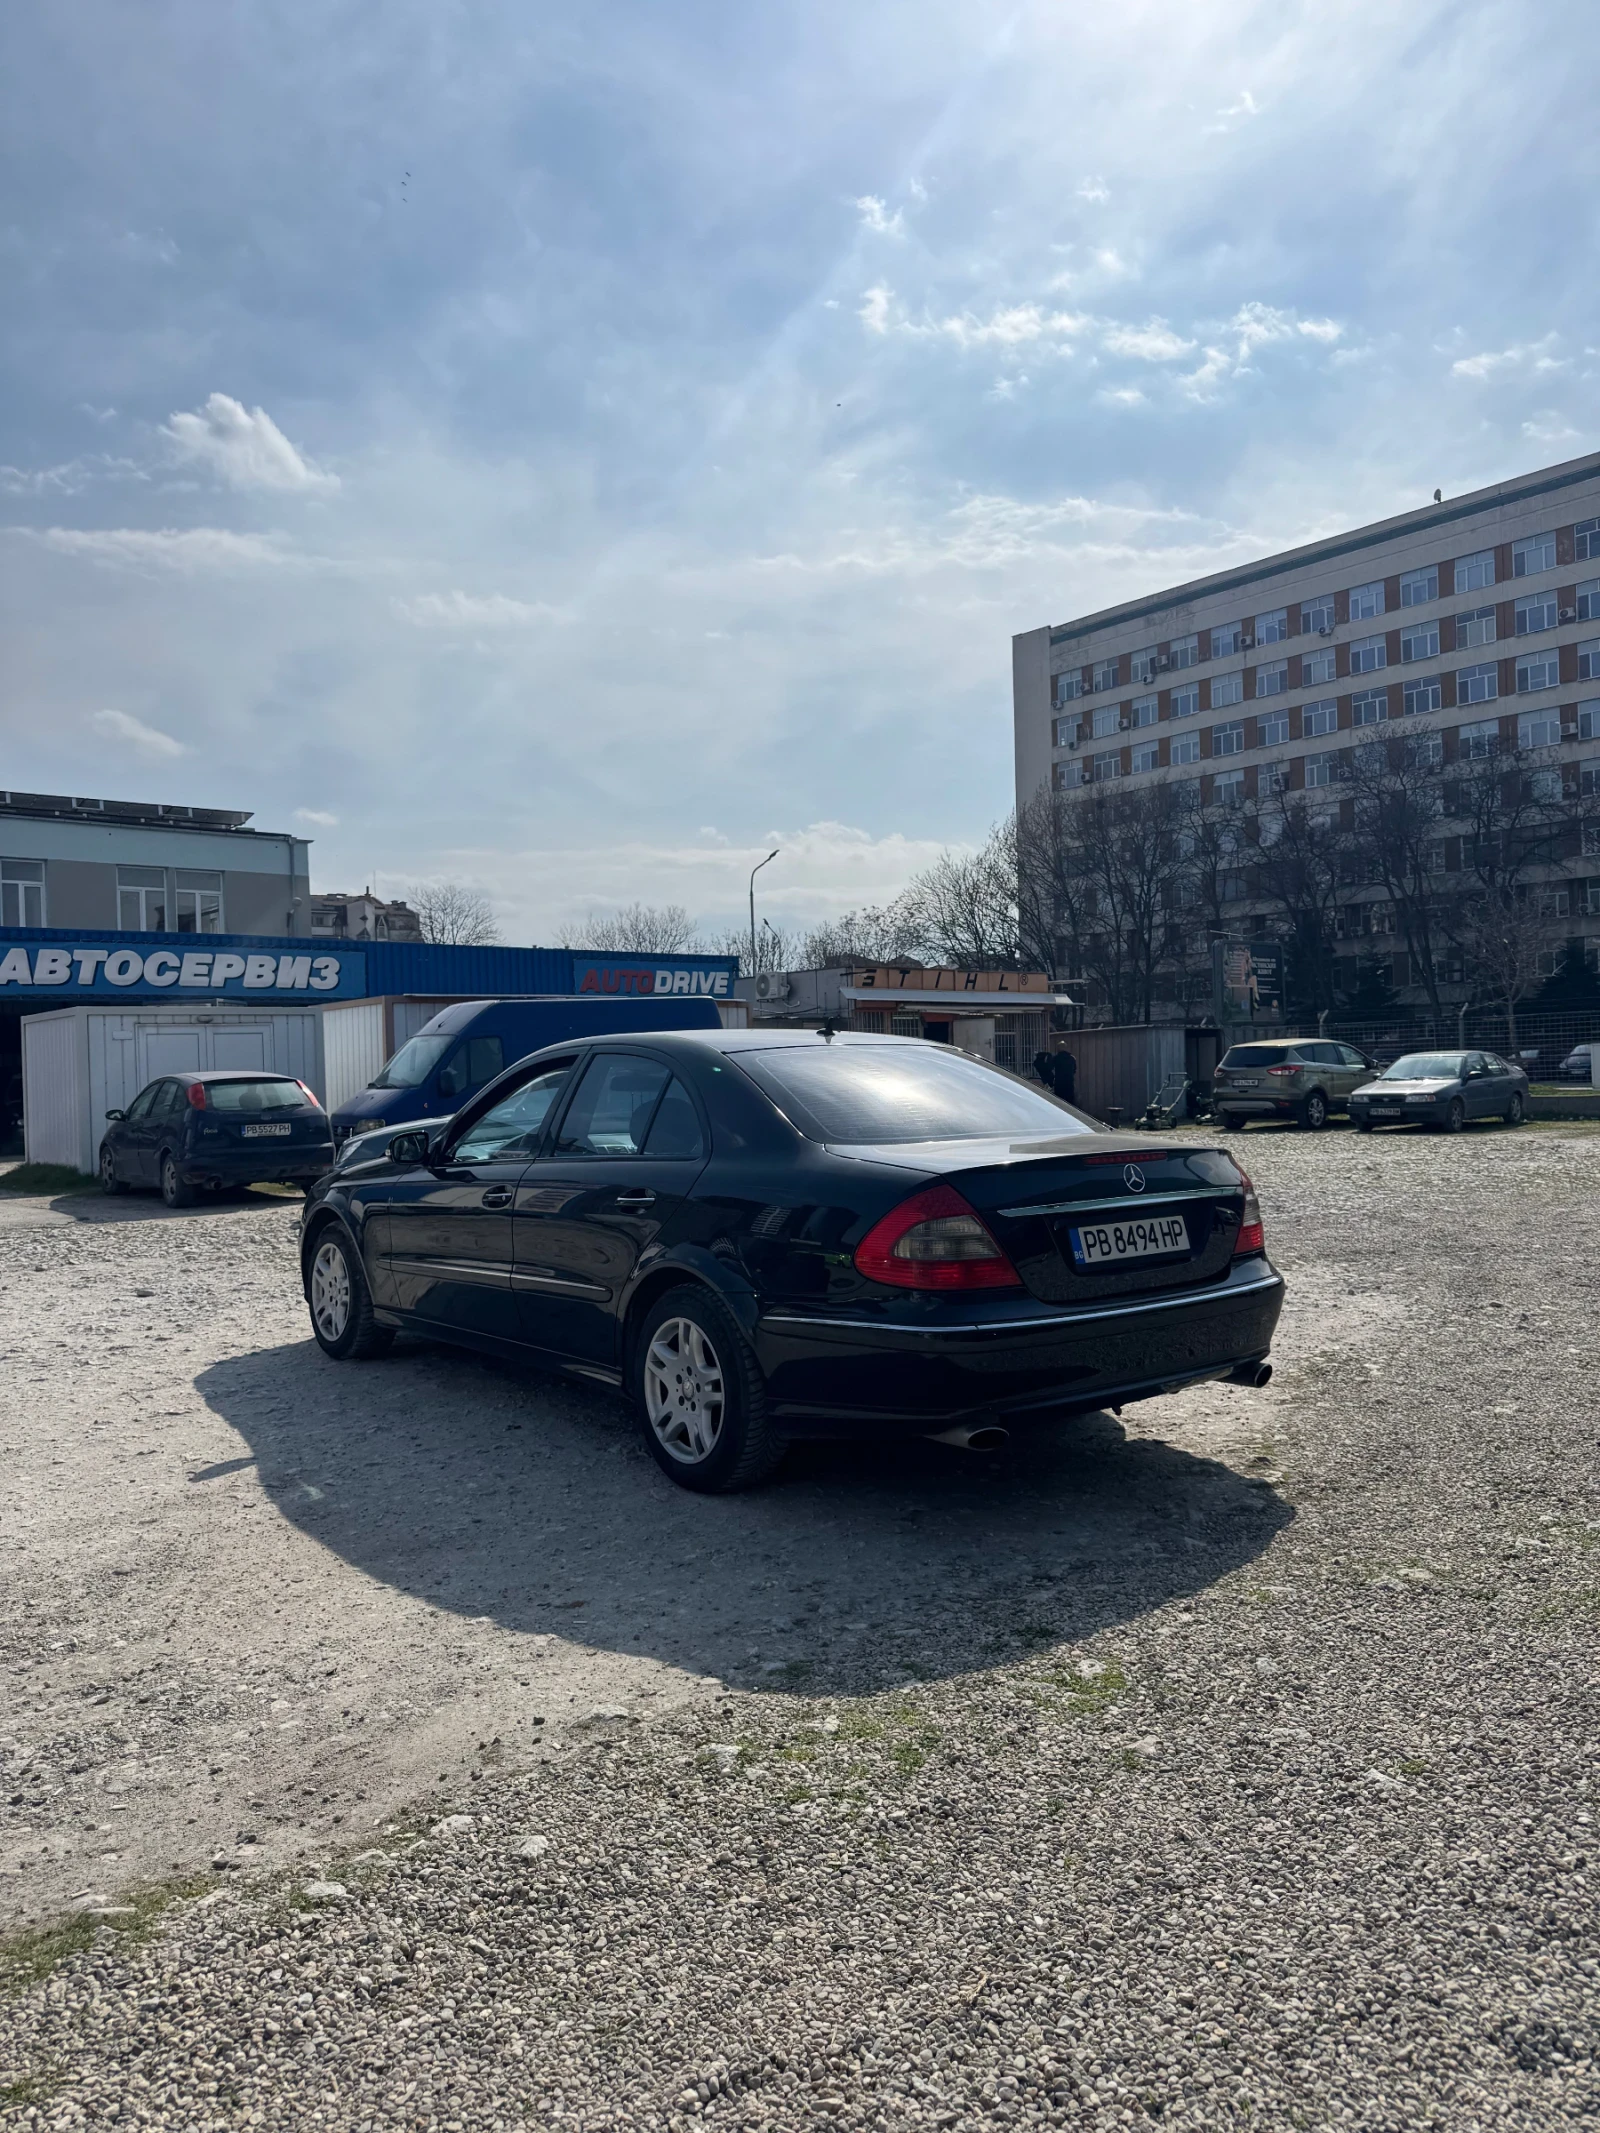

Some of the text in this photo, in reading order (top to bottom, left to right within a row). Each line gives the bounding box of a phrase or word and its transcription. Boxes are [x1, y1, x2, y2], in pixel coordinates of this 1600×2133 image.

[0, 948, 341, 990] АВТОСЕРВИЗ
[1083, 1220, 1183, 1258] PB 8494 HP
